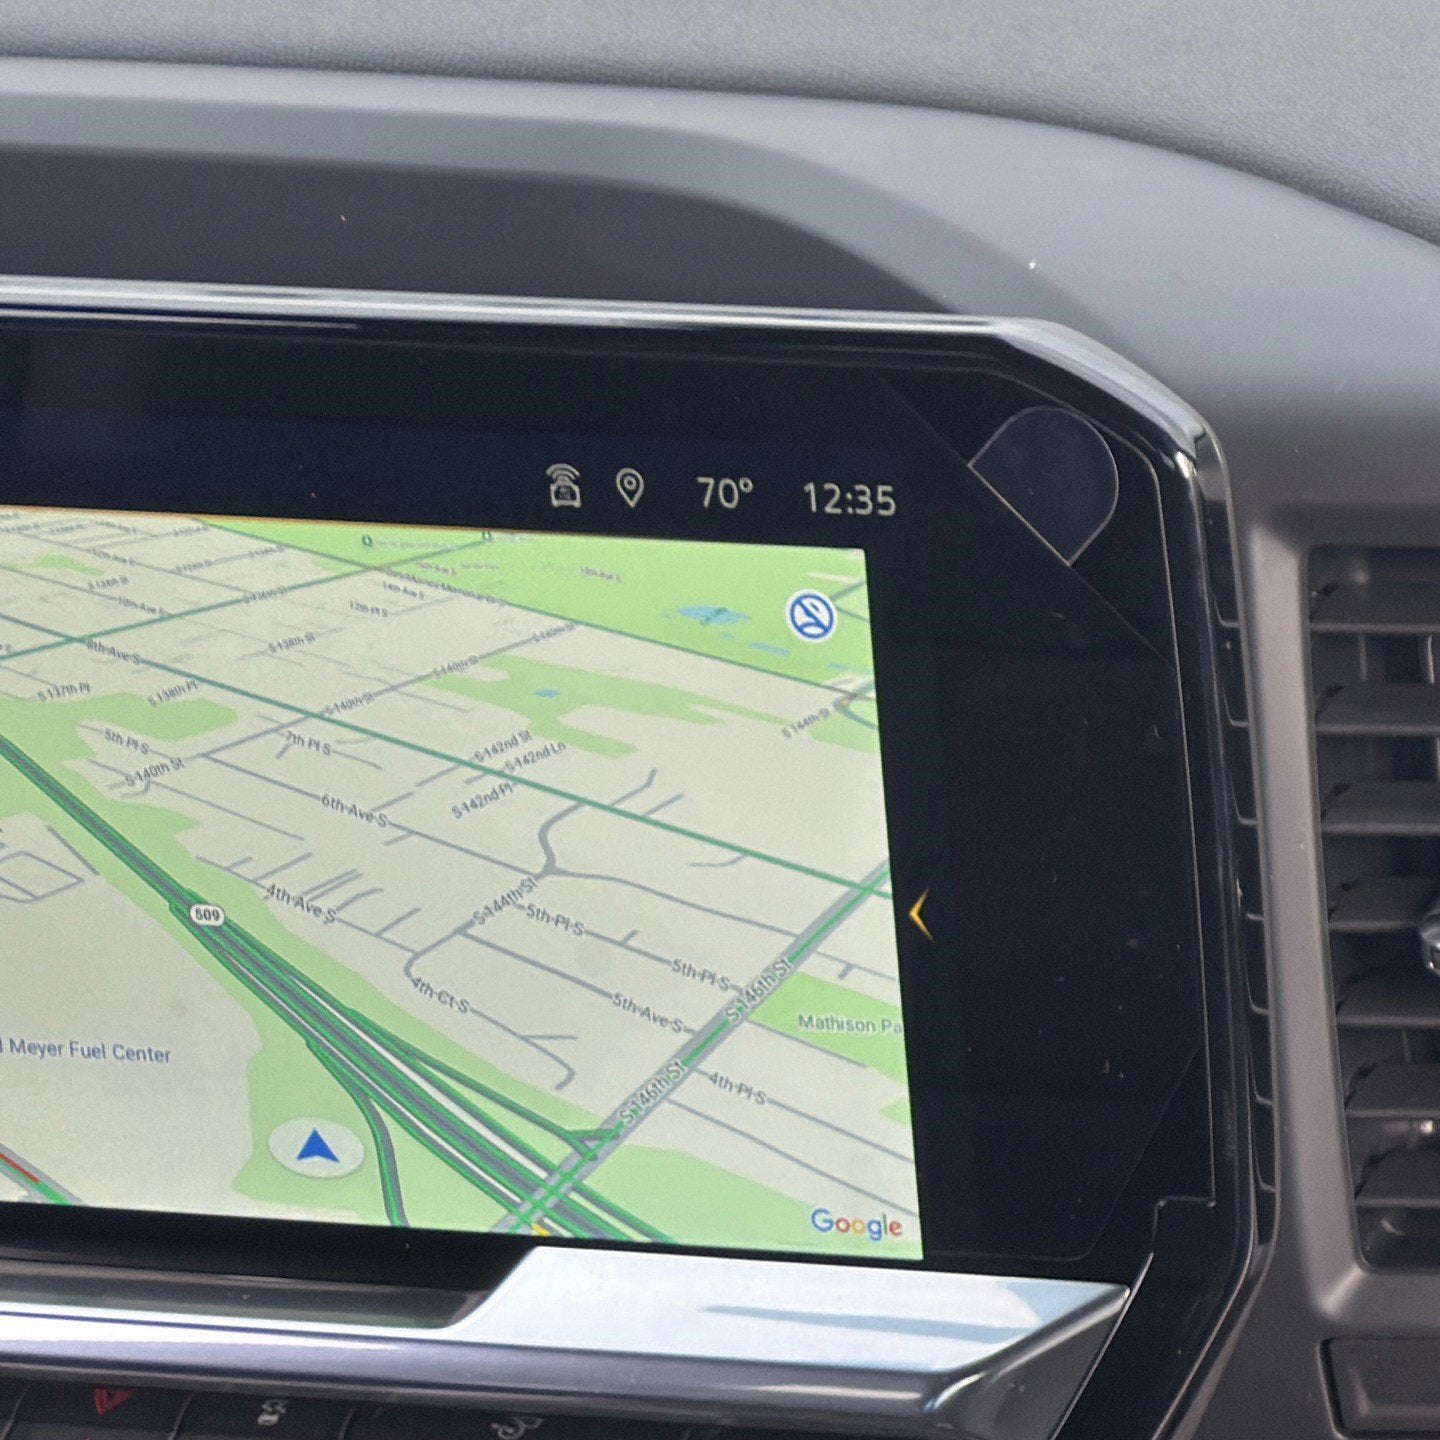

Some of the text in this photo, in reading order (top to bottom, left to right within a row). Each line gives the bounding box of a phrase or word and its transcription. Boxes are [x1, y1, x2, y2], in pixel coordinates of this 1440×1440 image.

[803, 482, 897, 517] 12:35
[104, 728, 150, 755] 5th Pl S
[286, 729, 332, 756] 7th Pl S
[125, 757, 185, 787] S 140th St
[321, 793, 389, 828] 6th Ave S
[451, 779, 514, 819] S 142nd Pl
[266, 883, 337, 924] 4th Ave S
[473, 876, 538, 926] S 144th St
[526, 902, 586, 937] 5th Pl S
[671, 958, 731, 992] 5th Pl S
[724, 957, 793, 1024] S 146th St
[411, 976, 471, 1015] 4th Ct S
[612, 992, 684, 1035] 5th Ave S
[797, 1013, 877, 1034] Mathison
[9, 1036, 172, 1064] Meyer Fuel Center
[619, 1059, 686, 1127] S 146th St
[708, 1071, 768, 1106] 4th Pl S
[810, 1207, 904, 1242] Google
